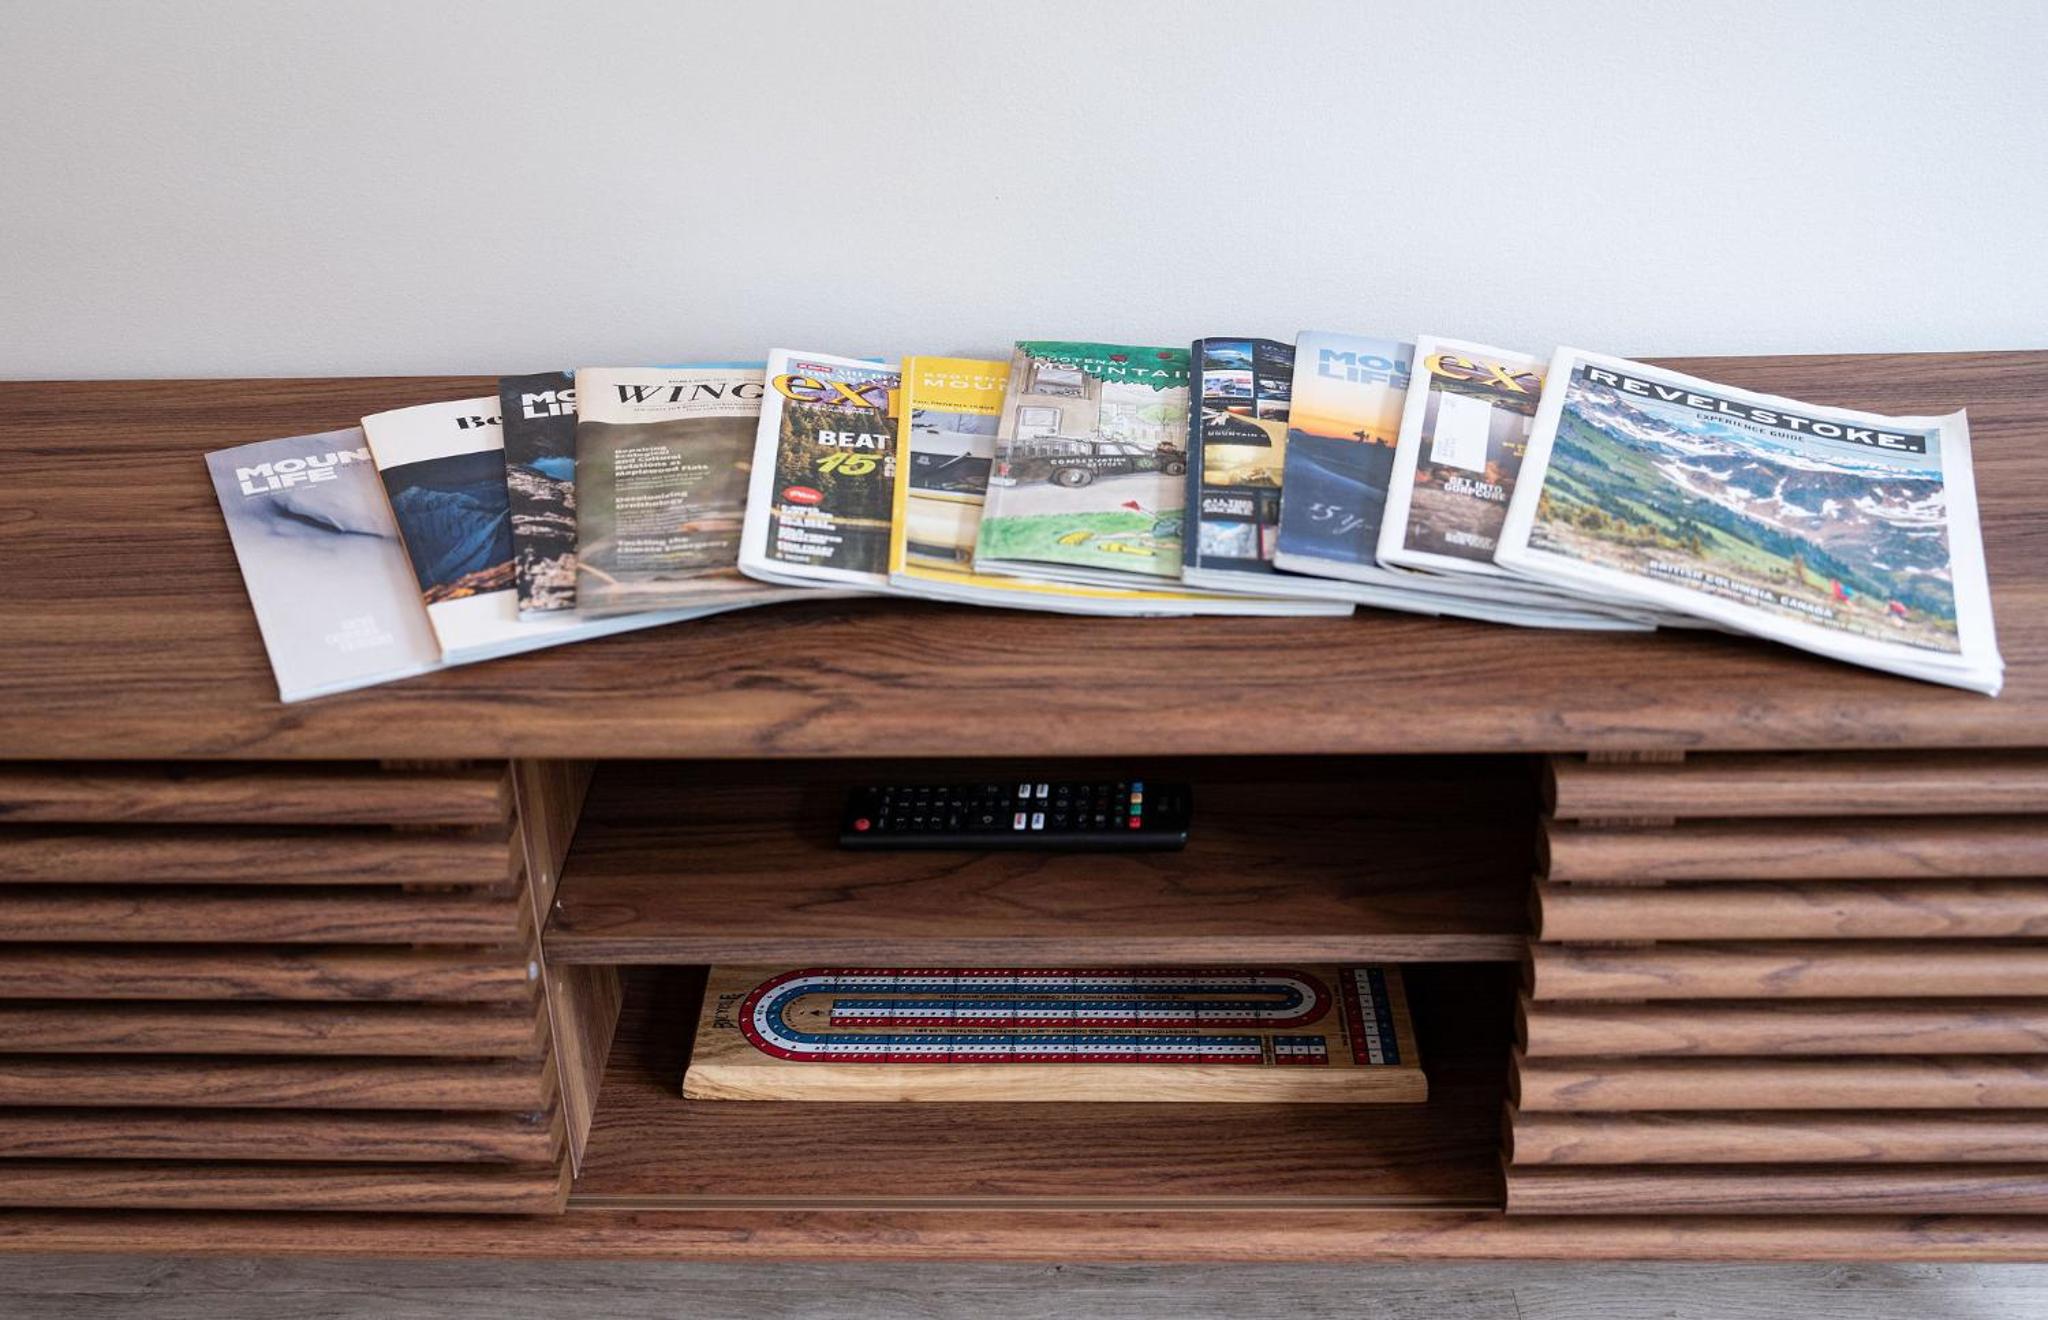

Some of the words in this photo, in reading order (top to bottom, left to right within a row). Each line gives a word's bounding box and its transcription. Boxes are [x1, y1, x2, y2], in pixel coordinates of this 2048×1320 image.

[1318, 363, 1409, 389] LIFE
[1424, 352, 1546, 394] ex
[1590, 367, 1919, 451] REVELSTOKE.
[818, 429, 891, 449] BEAT
[1696, 412, 1767, 435] EXPERIENCE
[1769, 429, 1804, 442] GUIDE
[235, 447, 372, 482] MOUN
[816, 451, 883, 476] 15
[240, 466, 338, 496] LIFE
[1780, 596, 1833, 618] CANADA
